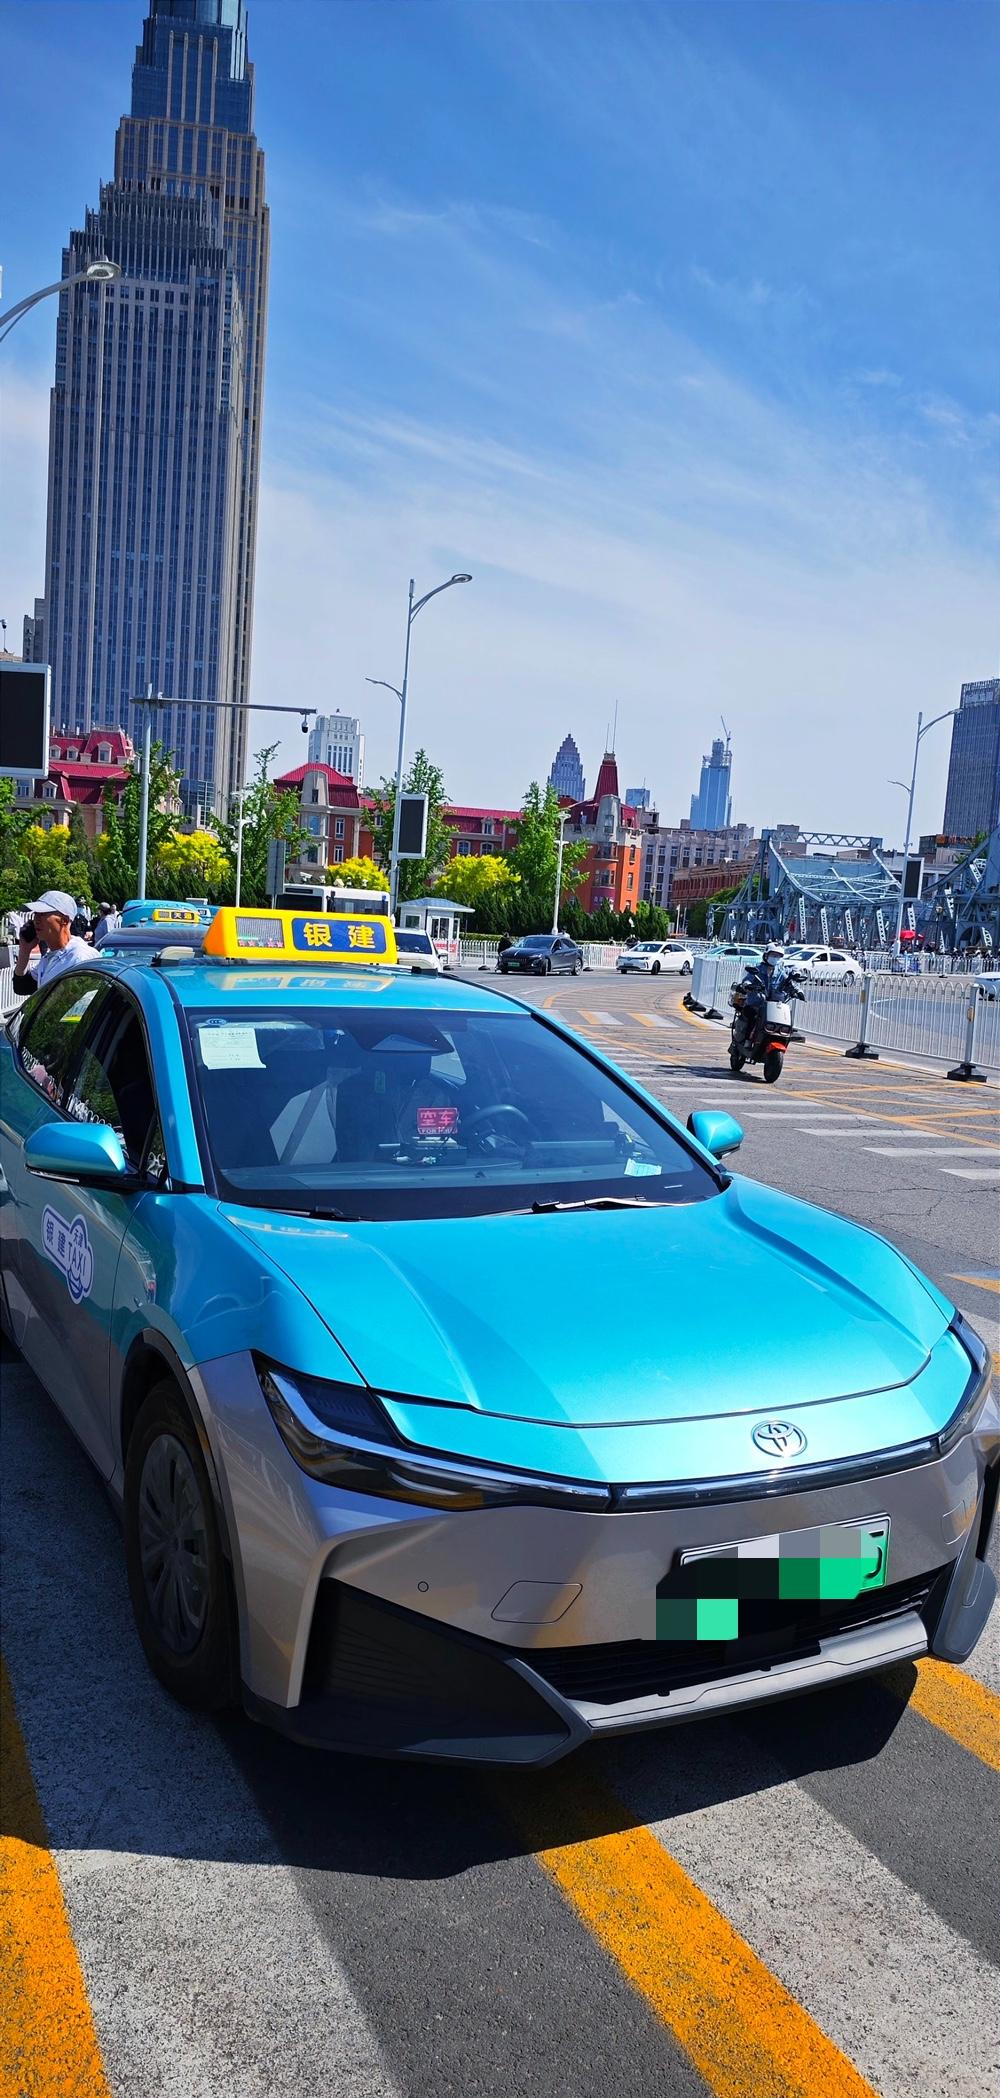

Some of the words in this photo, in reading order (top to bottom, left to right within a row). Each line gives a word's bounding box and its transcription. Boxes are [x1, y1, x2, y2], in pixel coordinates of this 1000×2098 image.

[303, 922, 376, 949] 银建
[420, 1109, 455, 1126] 空车
[46, 1218, 66, 1259] 银建
[68, 1241, 86, 1276] TAXI
